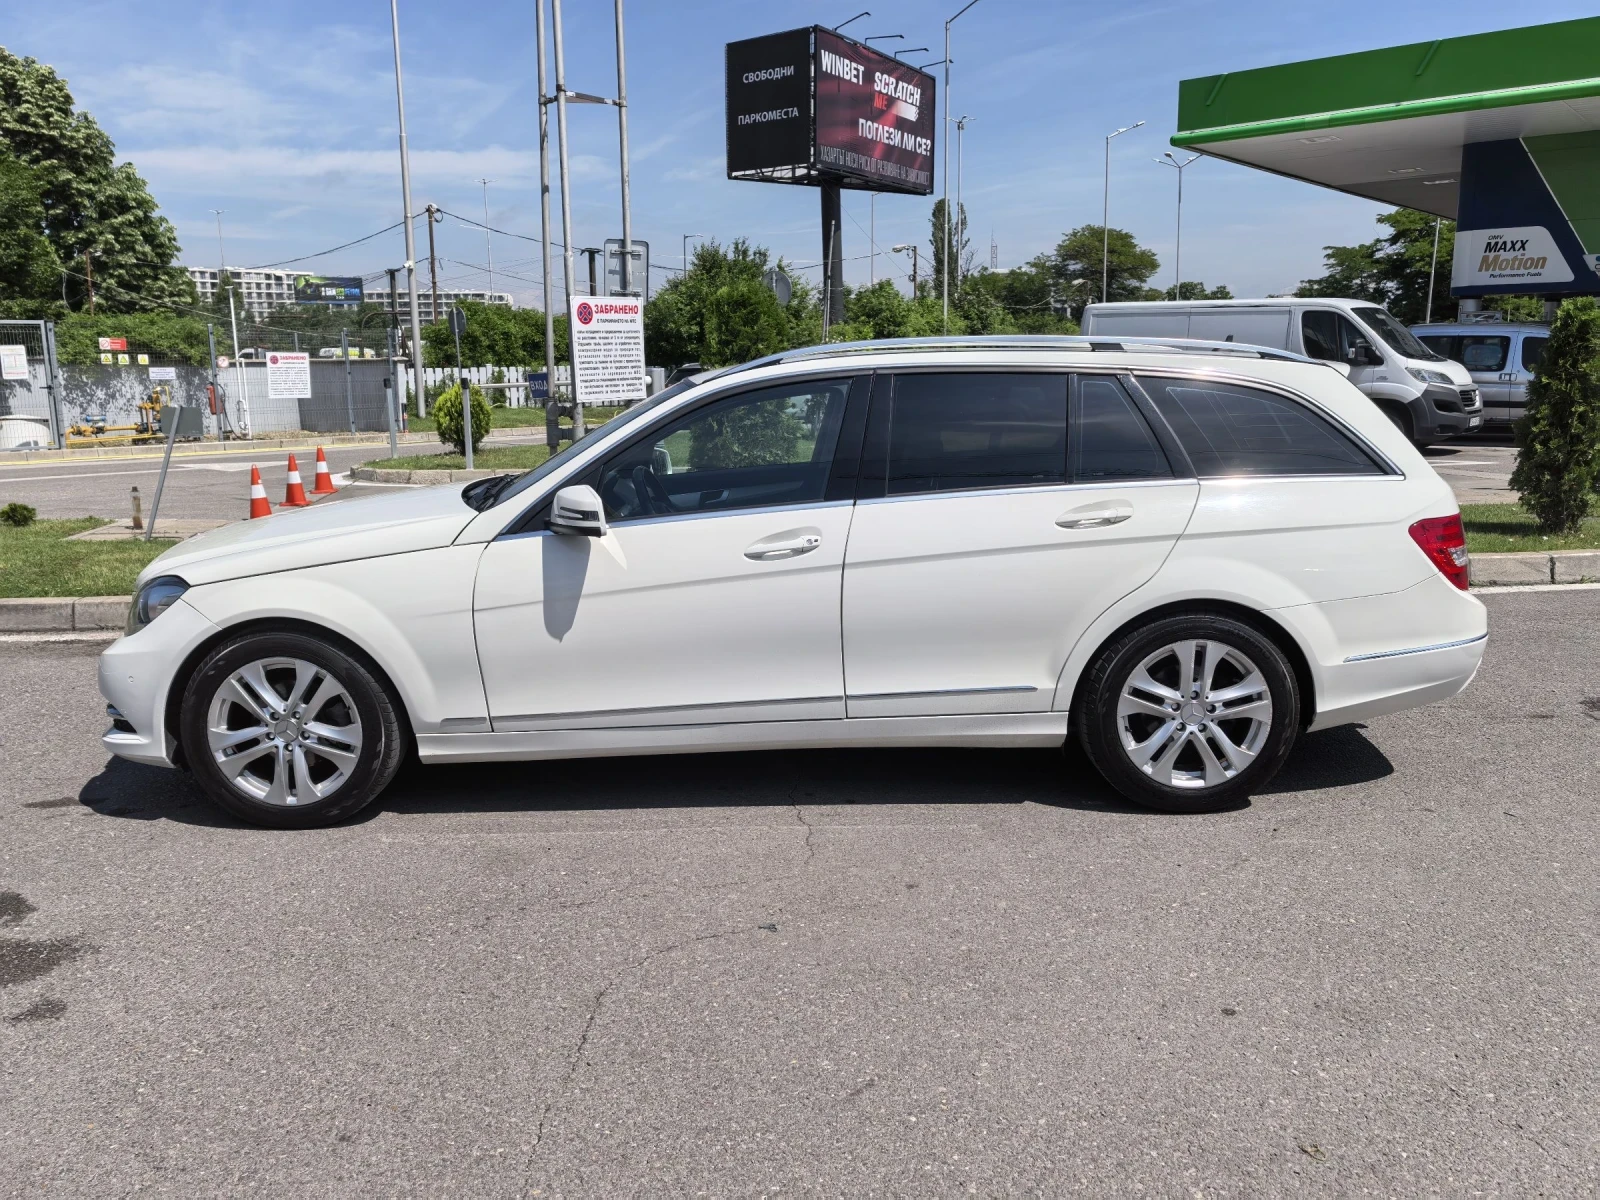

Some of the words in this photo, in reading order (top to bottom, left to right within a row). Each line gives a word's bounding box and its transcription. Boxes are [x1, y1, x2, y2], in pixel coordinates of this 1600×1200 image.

[743, 65, 794, 83] СВОБОДНИ
[821, 49, 864, 86] WINBET
[874, 71, 920, 106] SCRATCH
[874, 92, 888, 110] ME
[738, 107, 799, 125] ПАРКОМЕСТА
[858, 118, 901, 148] ПОГЛЕЗИ
[903, 132, 915, 152] ЛИ
[916, 136, 931, 156] СЕ?
[820, 144, 845, 164] ХАЗАРТЪТ
[845, 151, 858, 168] НОСИ
[858, 154, 870, 171] РИСК
[871, 157, 877, 173] ОТ
[1484, 239, 1529, 253] MAXX
[1478, 253, 1548, 272] Motion
[594, 304, 638, 314] ЗАБРАНЕНО
[530, 380, 548, 390] ВХОД
